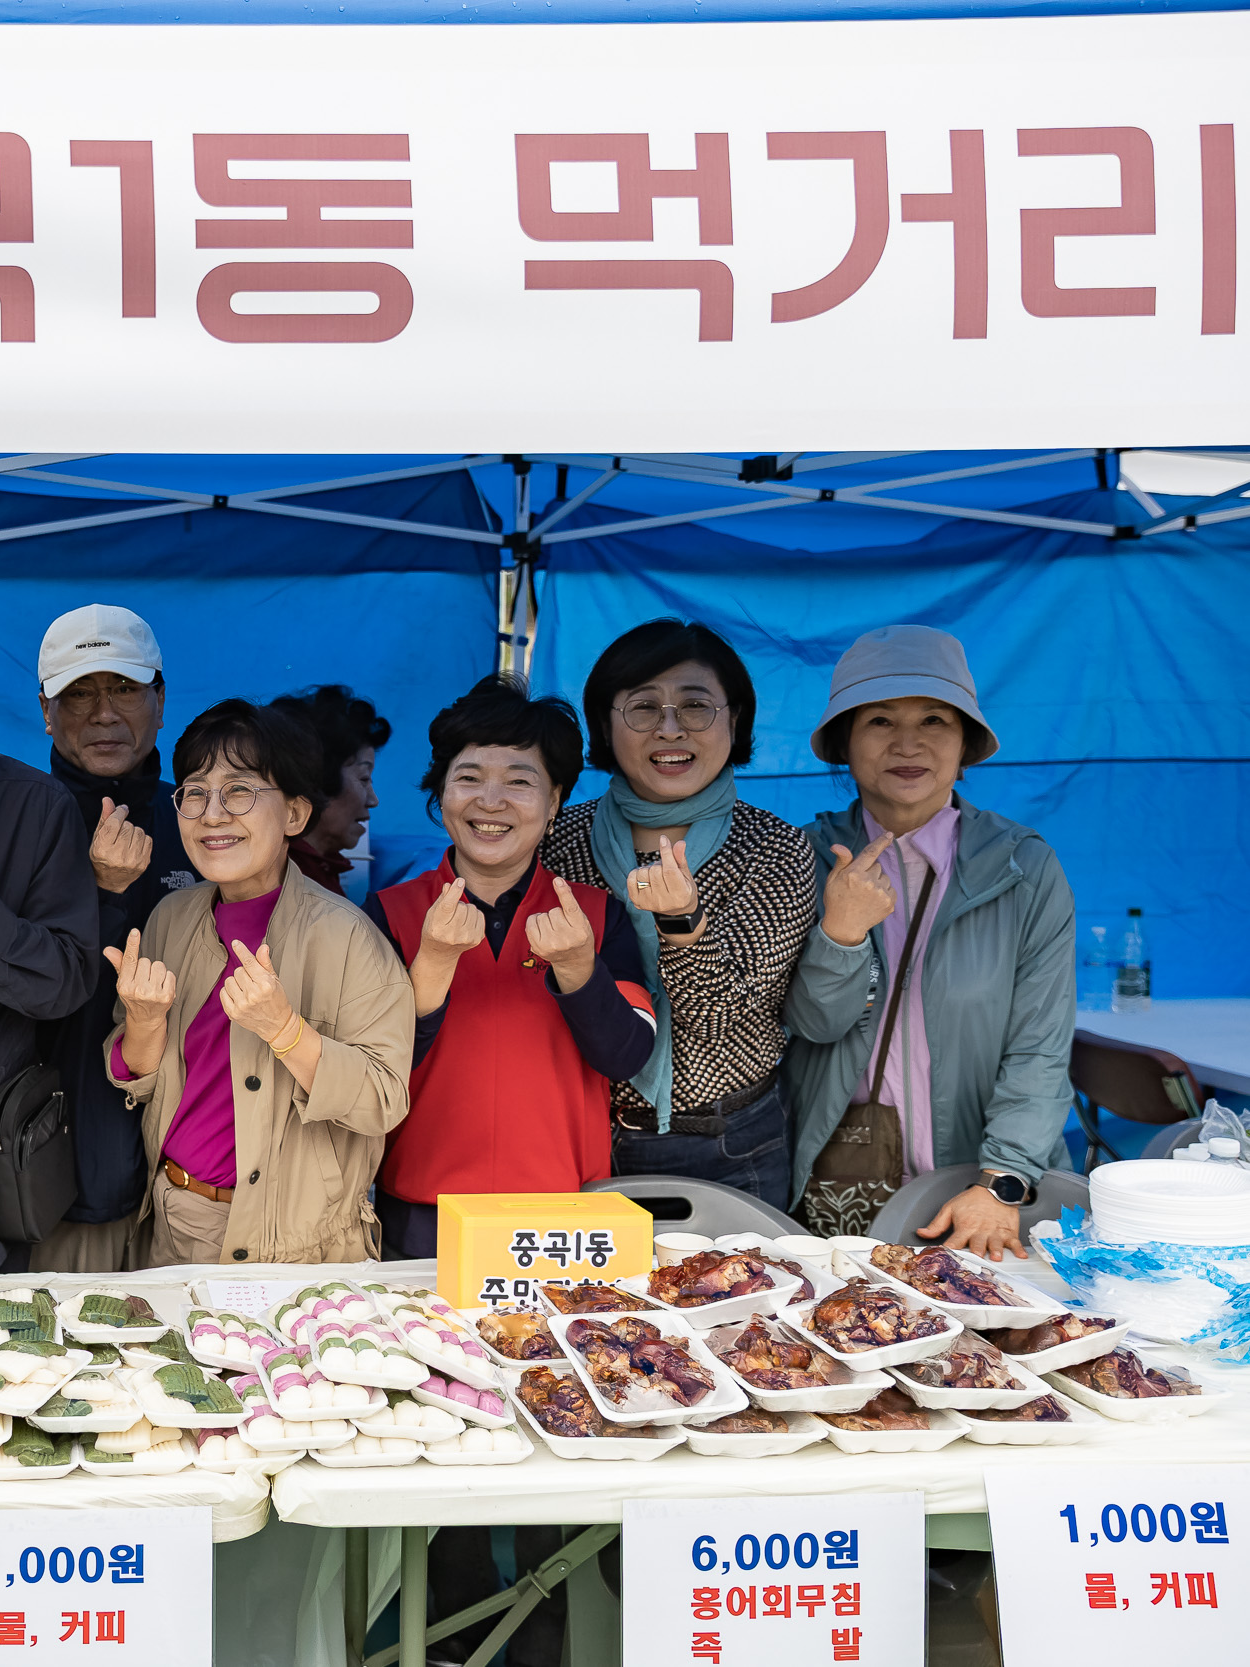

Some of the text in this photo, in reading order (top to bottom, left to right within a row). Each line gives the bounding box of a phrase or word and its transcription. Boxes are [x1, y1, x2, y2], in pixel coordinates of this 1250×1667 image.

[516, 124, 1236, 341] 먹거리
[160, 876, 186, 884] NORTH
[512, 1232, 613, 1267] 중곡1동
[1060, 1502, 1229, 1547] 1,000원
[692, 1530, 858, 1575] 6,000원
[691, 1583, 860, 1620] 홍어회무침
[1085, 1572, 1218, 1610] 물, 커피
[59, 1610, 125, 1644] 커피
